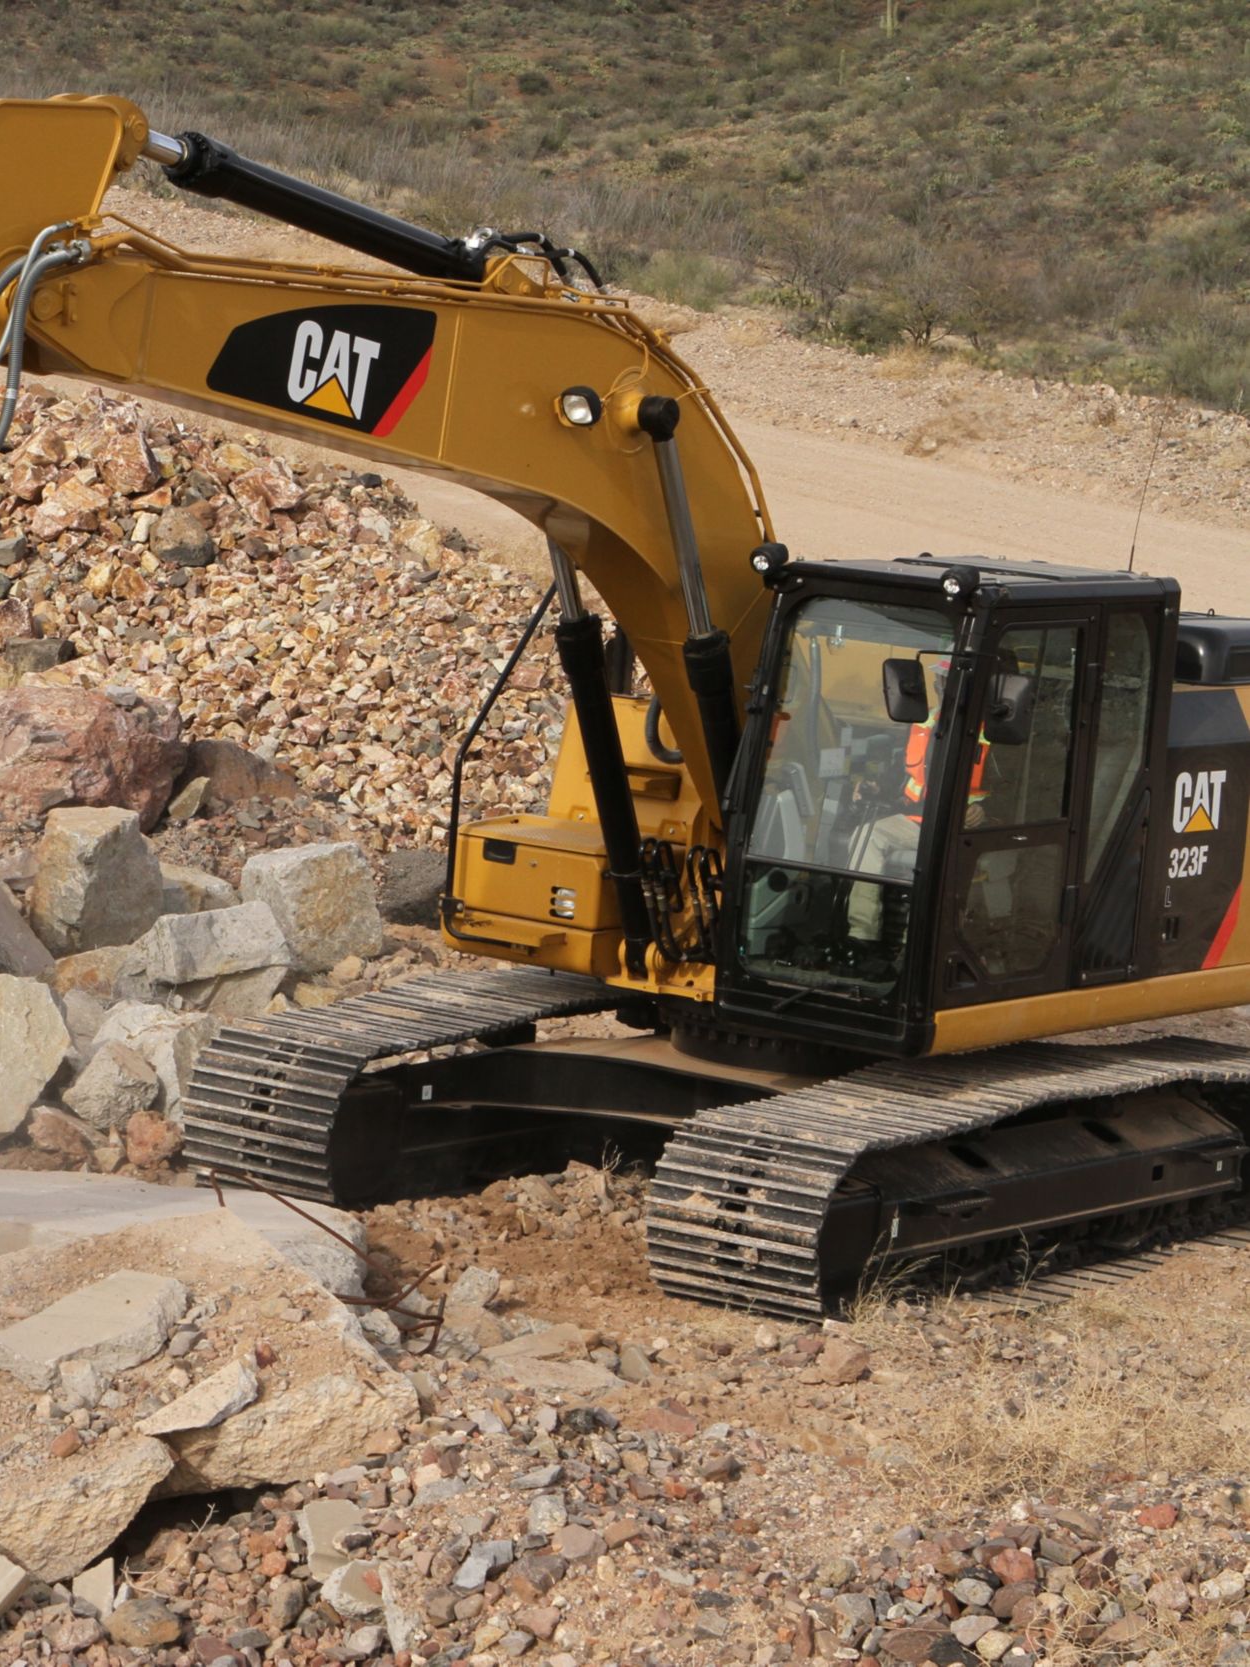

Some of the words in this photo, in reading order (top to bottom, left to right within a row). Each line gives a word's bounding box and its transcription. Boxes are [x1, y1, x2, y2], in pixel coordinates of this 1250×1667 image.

[287, 320, 381, 420] CAT
[1173, 770, 1227, 833] CAT
[1168, 845, 1209, 879] 323F
